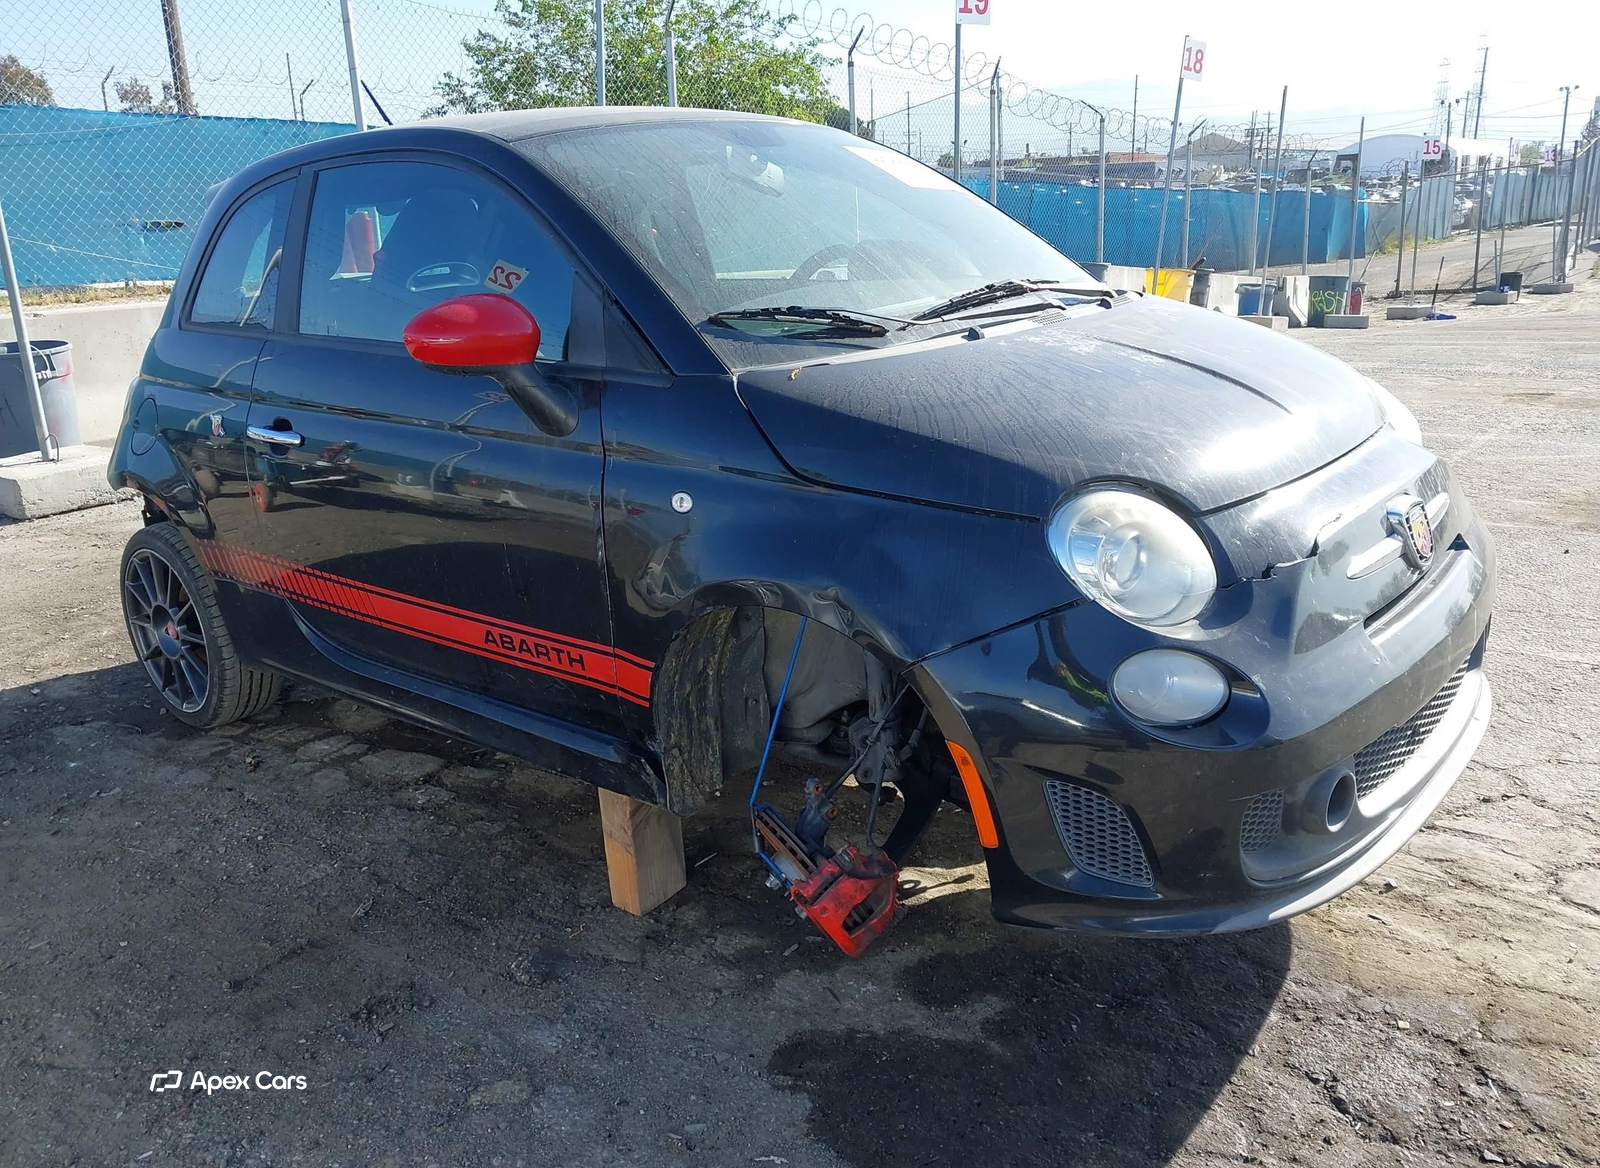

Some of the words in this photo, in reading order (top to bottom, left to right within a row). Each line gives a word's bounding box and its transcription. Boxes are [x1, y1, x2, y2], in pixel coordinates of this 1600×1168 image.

[1183, 46, 1204, 74] 18
[1423, 139, 1441, 155] 15
[1545, 149, 1556, 162] 13
[484, 629, 586, 671] ABARTH
